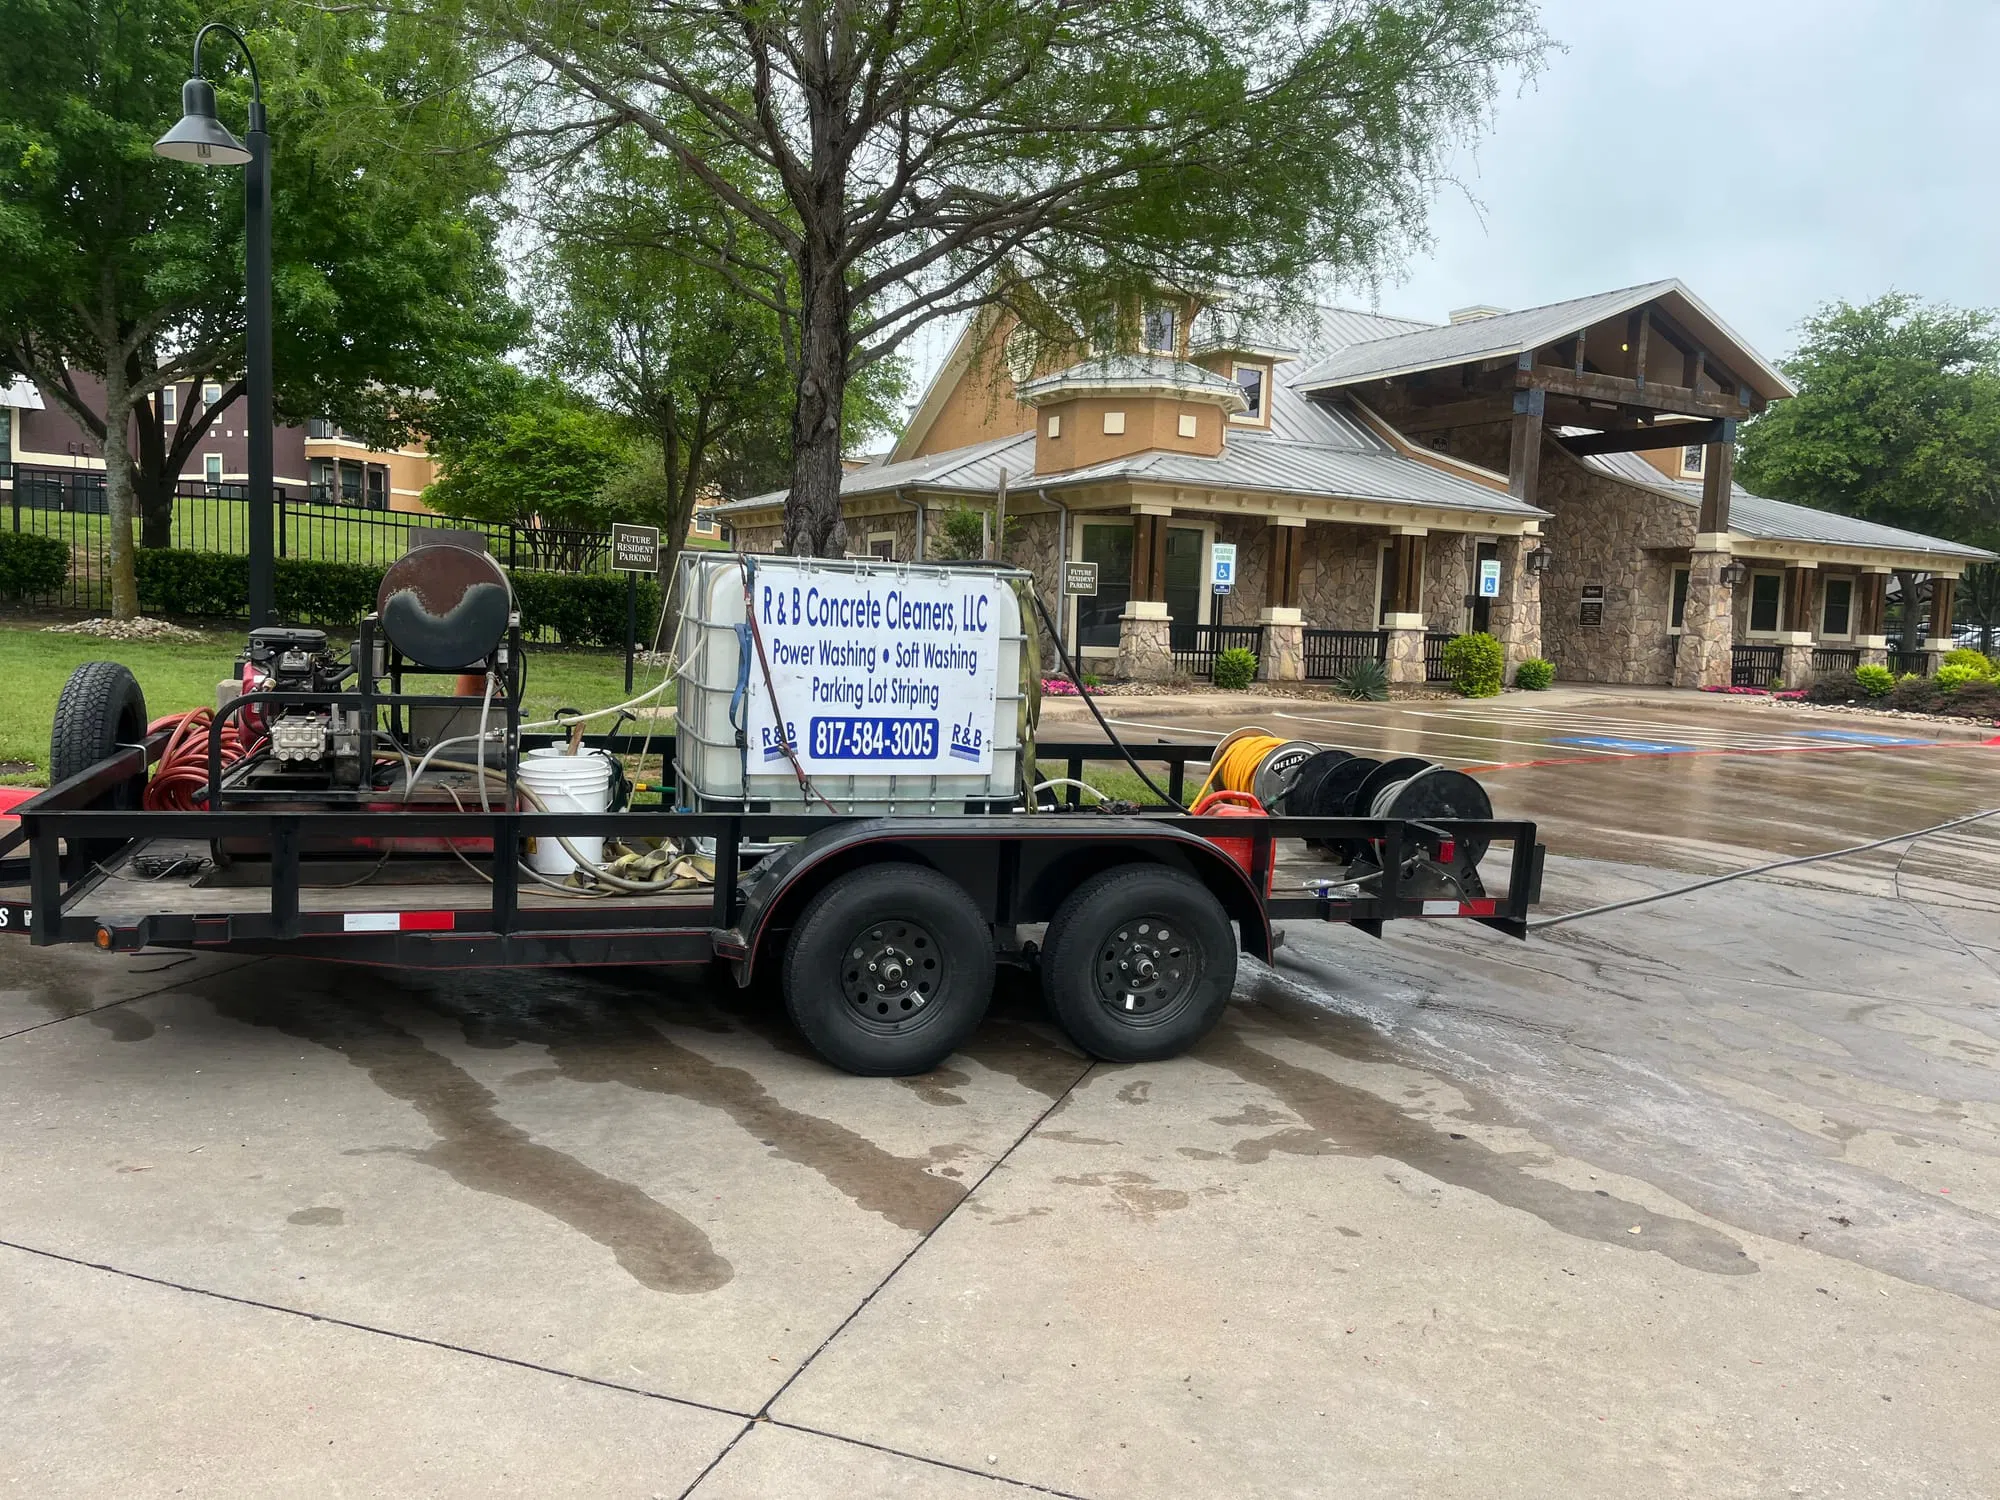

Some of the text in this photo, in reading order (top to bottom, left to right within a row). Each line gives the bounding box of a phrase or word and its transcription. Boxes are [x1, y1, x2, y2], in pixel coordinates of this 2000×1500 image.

[621, 533, 651, 544] FUTURE
[617, 542, 655, 554] RESIDENT
[619, 551, 652, 562] PARKING
[1070, 568, 1092, 576] FUTURE
[1067, 575, 1095, 583] RESIDENT
[1069, 581, 1093, 589] PARKING
[763, 585, 988, 636] R & B Concrete Cleaners, LLC
[773, 638, 977, 676] Power Washing Soft Washing
[812, 676, 939, 711] Parking Lot Striping
[815, 720, 934, 756] 817-584-3005
